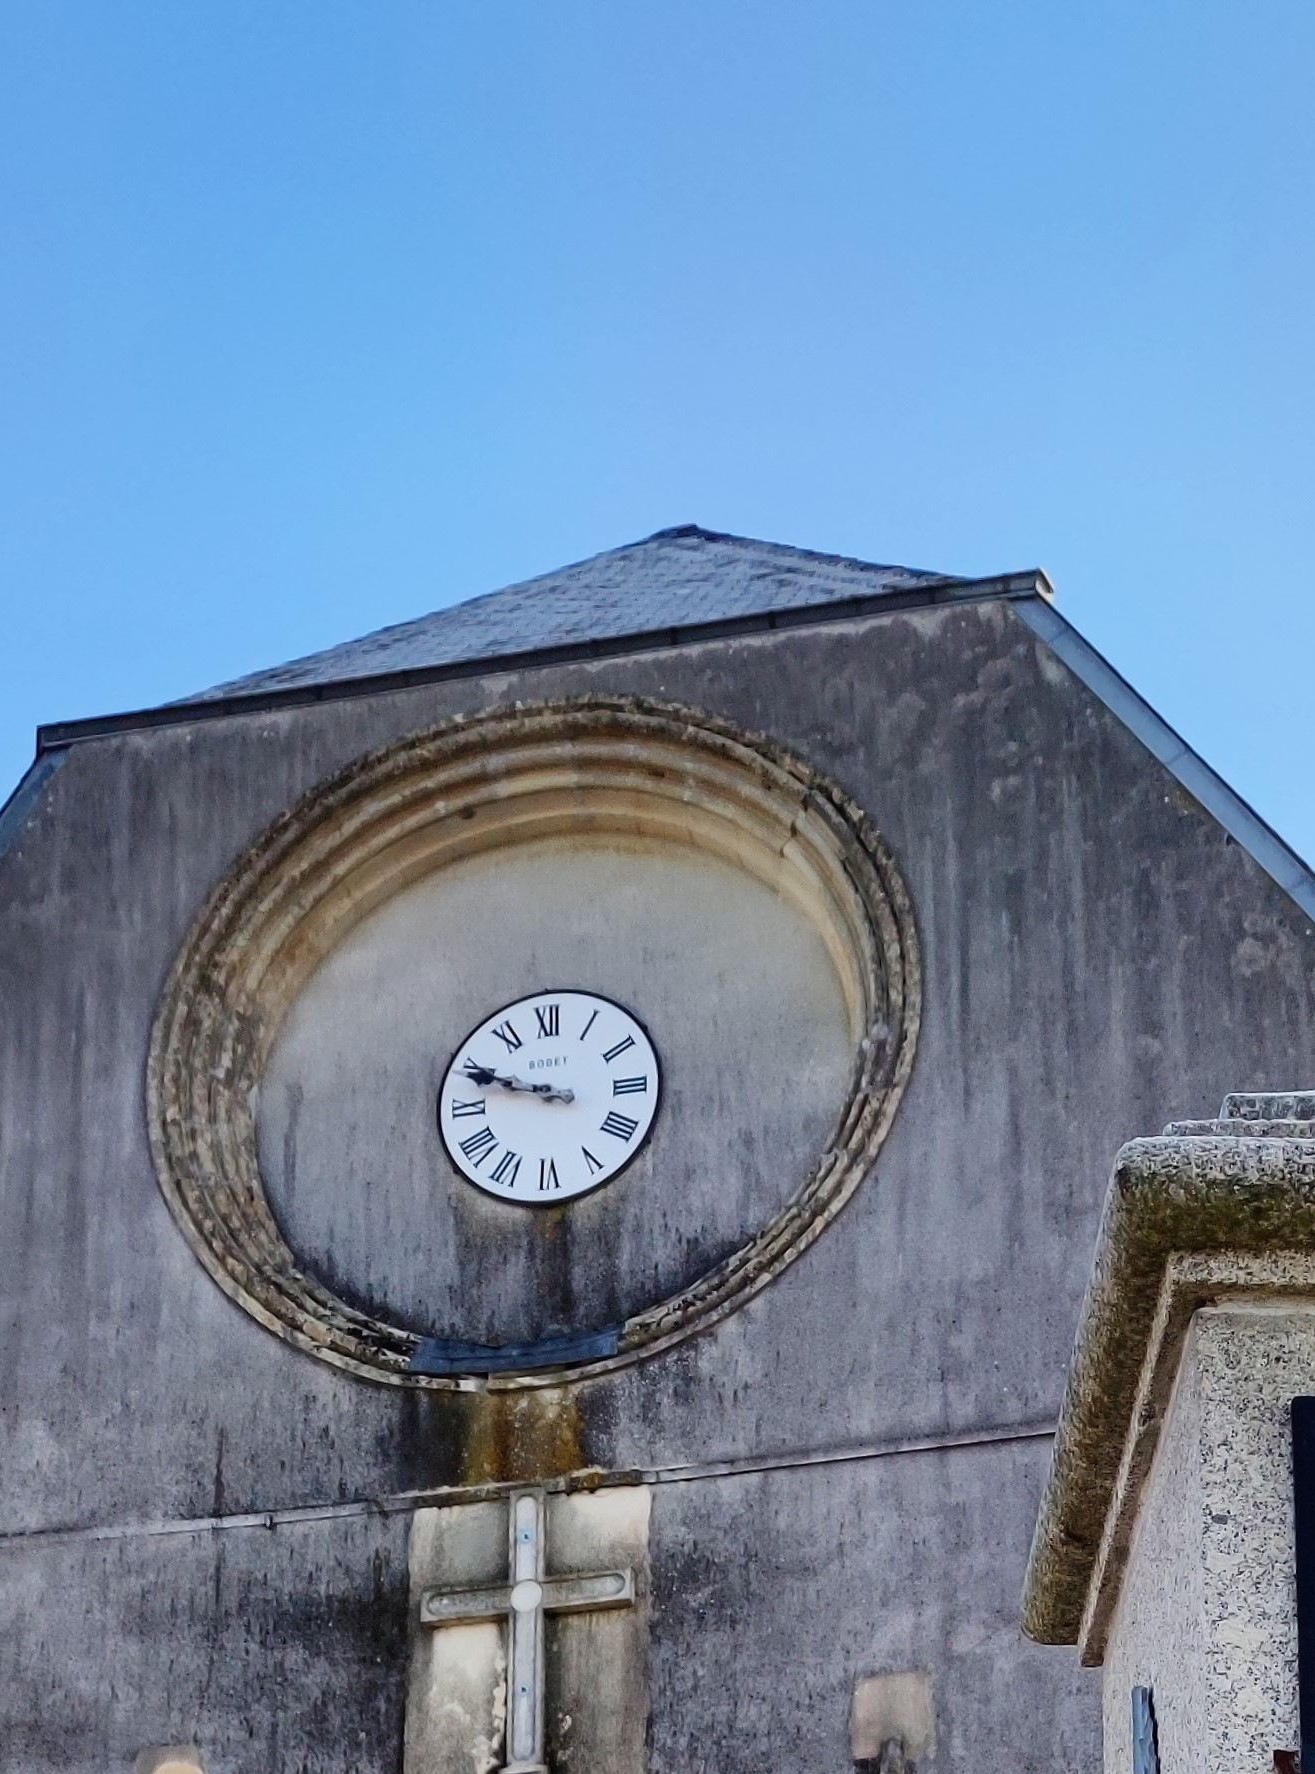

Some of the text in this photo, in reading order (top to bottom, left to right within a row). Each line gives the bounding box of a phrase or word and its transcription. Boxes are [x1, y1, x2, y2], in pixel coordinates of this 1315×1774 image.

[490, 1020, 524, 1054] XI
[534, 1004, 560, 1039] XII
[601, 1034, 637, 1063] II
[613, 1075, 647, 1096] III
[452, 1098, 486, 1119] IX
[600, 1111, 641, 1143] IIII
[458, 1126, 500, 1168] VIII
[581, 1145, 606, 1176] V
[488, 1149, 523, 1187] VII
[539, 1156, 561, 1191] VI
